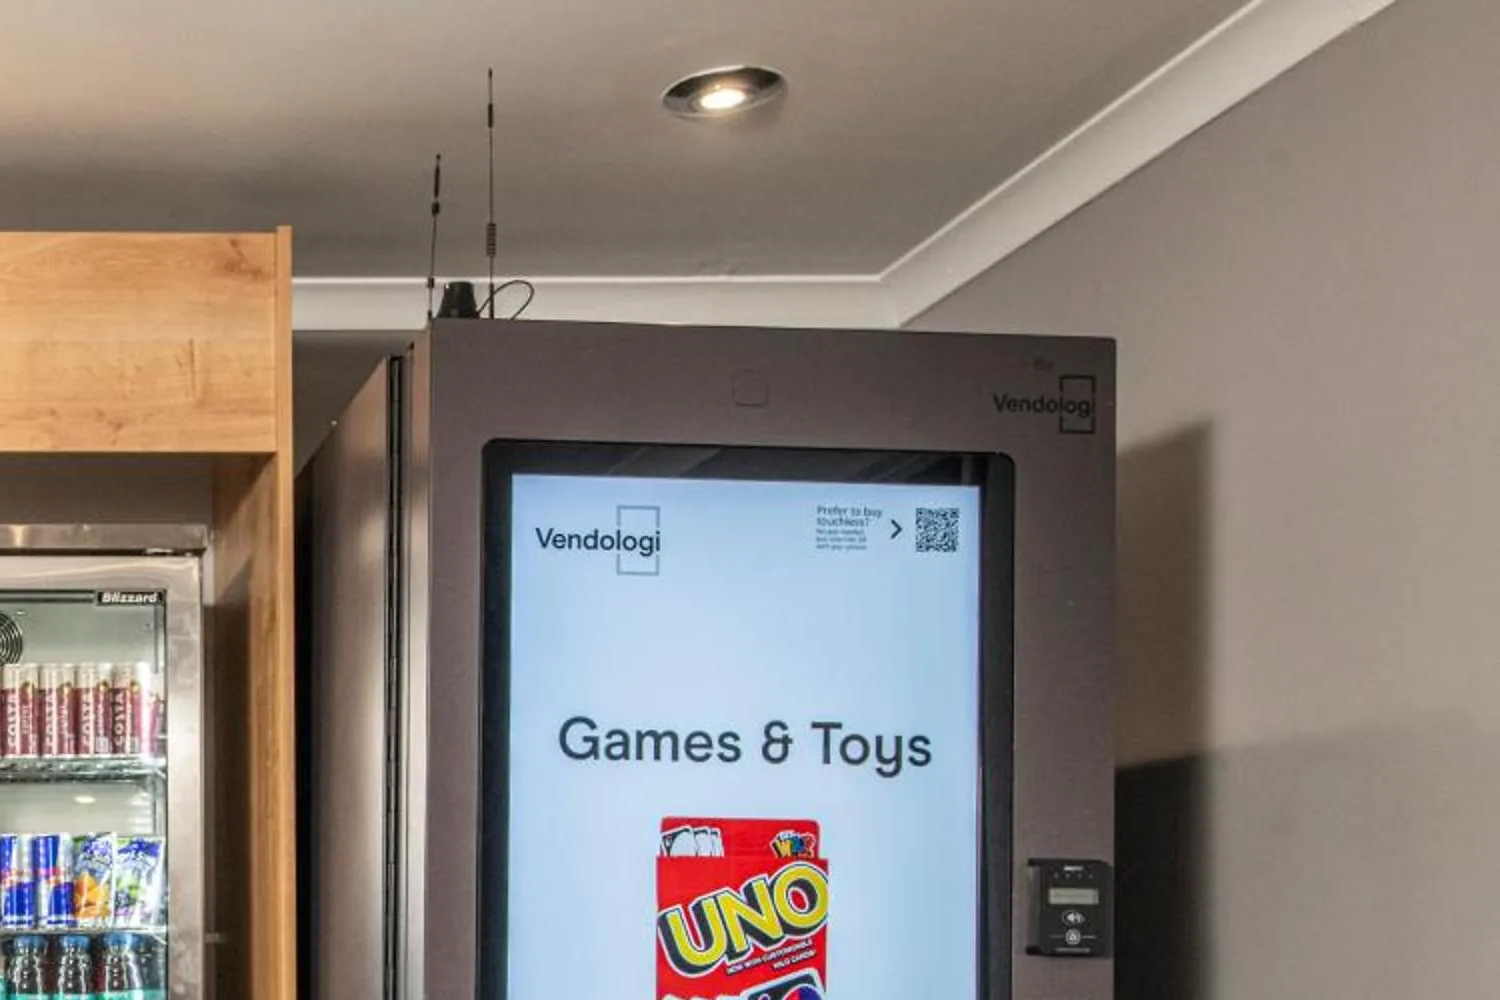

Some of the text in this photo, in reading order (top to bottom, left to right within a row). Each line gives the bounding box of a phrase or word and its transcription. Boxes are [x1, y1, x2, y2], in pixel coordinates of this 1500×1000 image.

[816, 505, 848, 518] Prefer
[864, 506, 883, 519] buy
[536, 527, 661, 557] Vendologi
[102, 592, 158, 603] Blizzard
[114, 691, 124, 747] COSTA
[558, 715, 933, 779] Games & Toys
[662, 863, 828, 975] UNO
